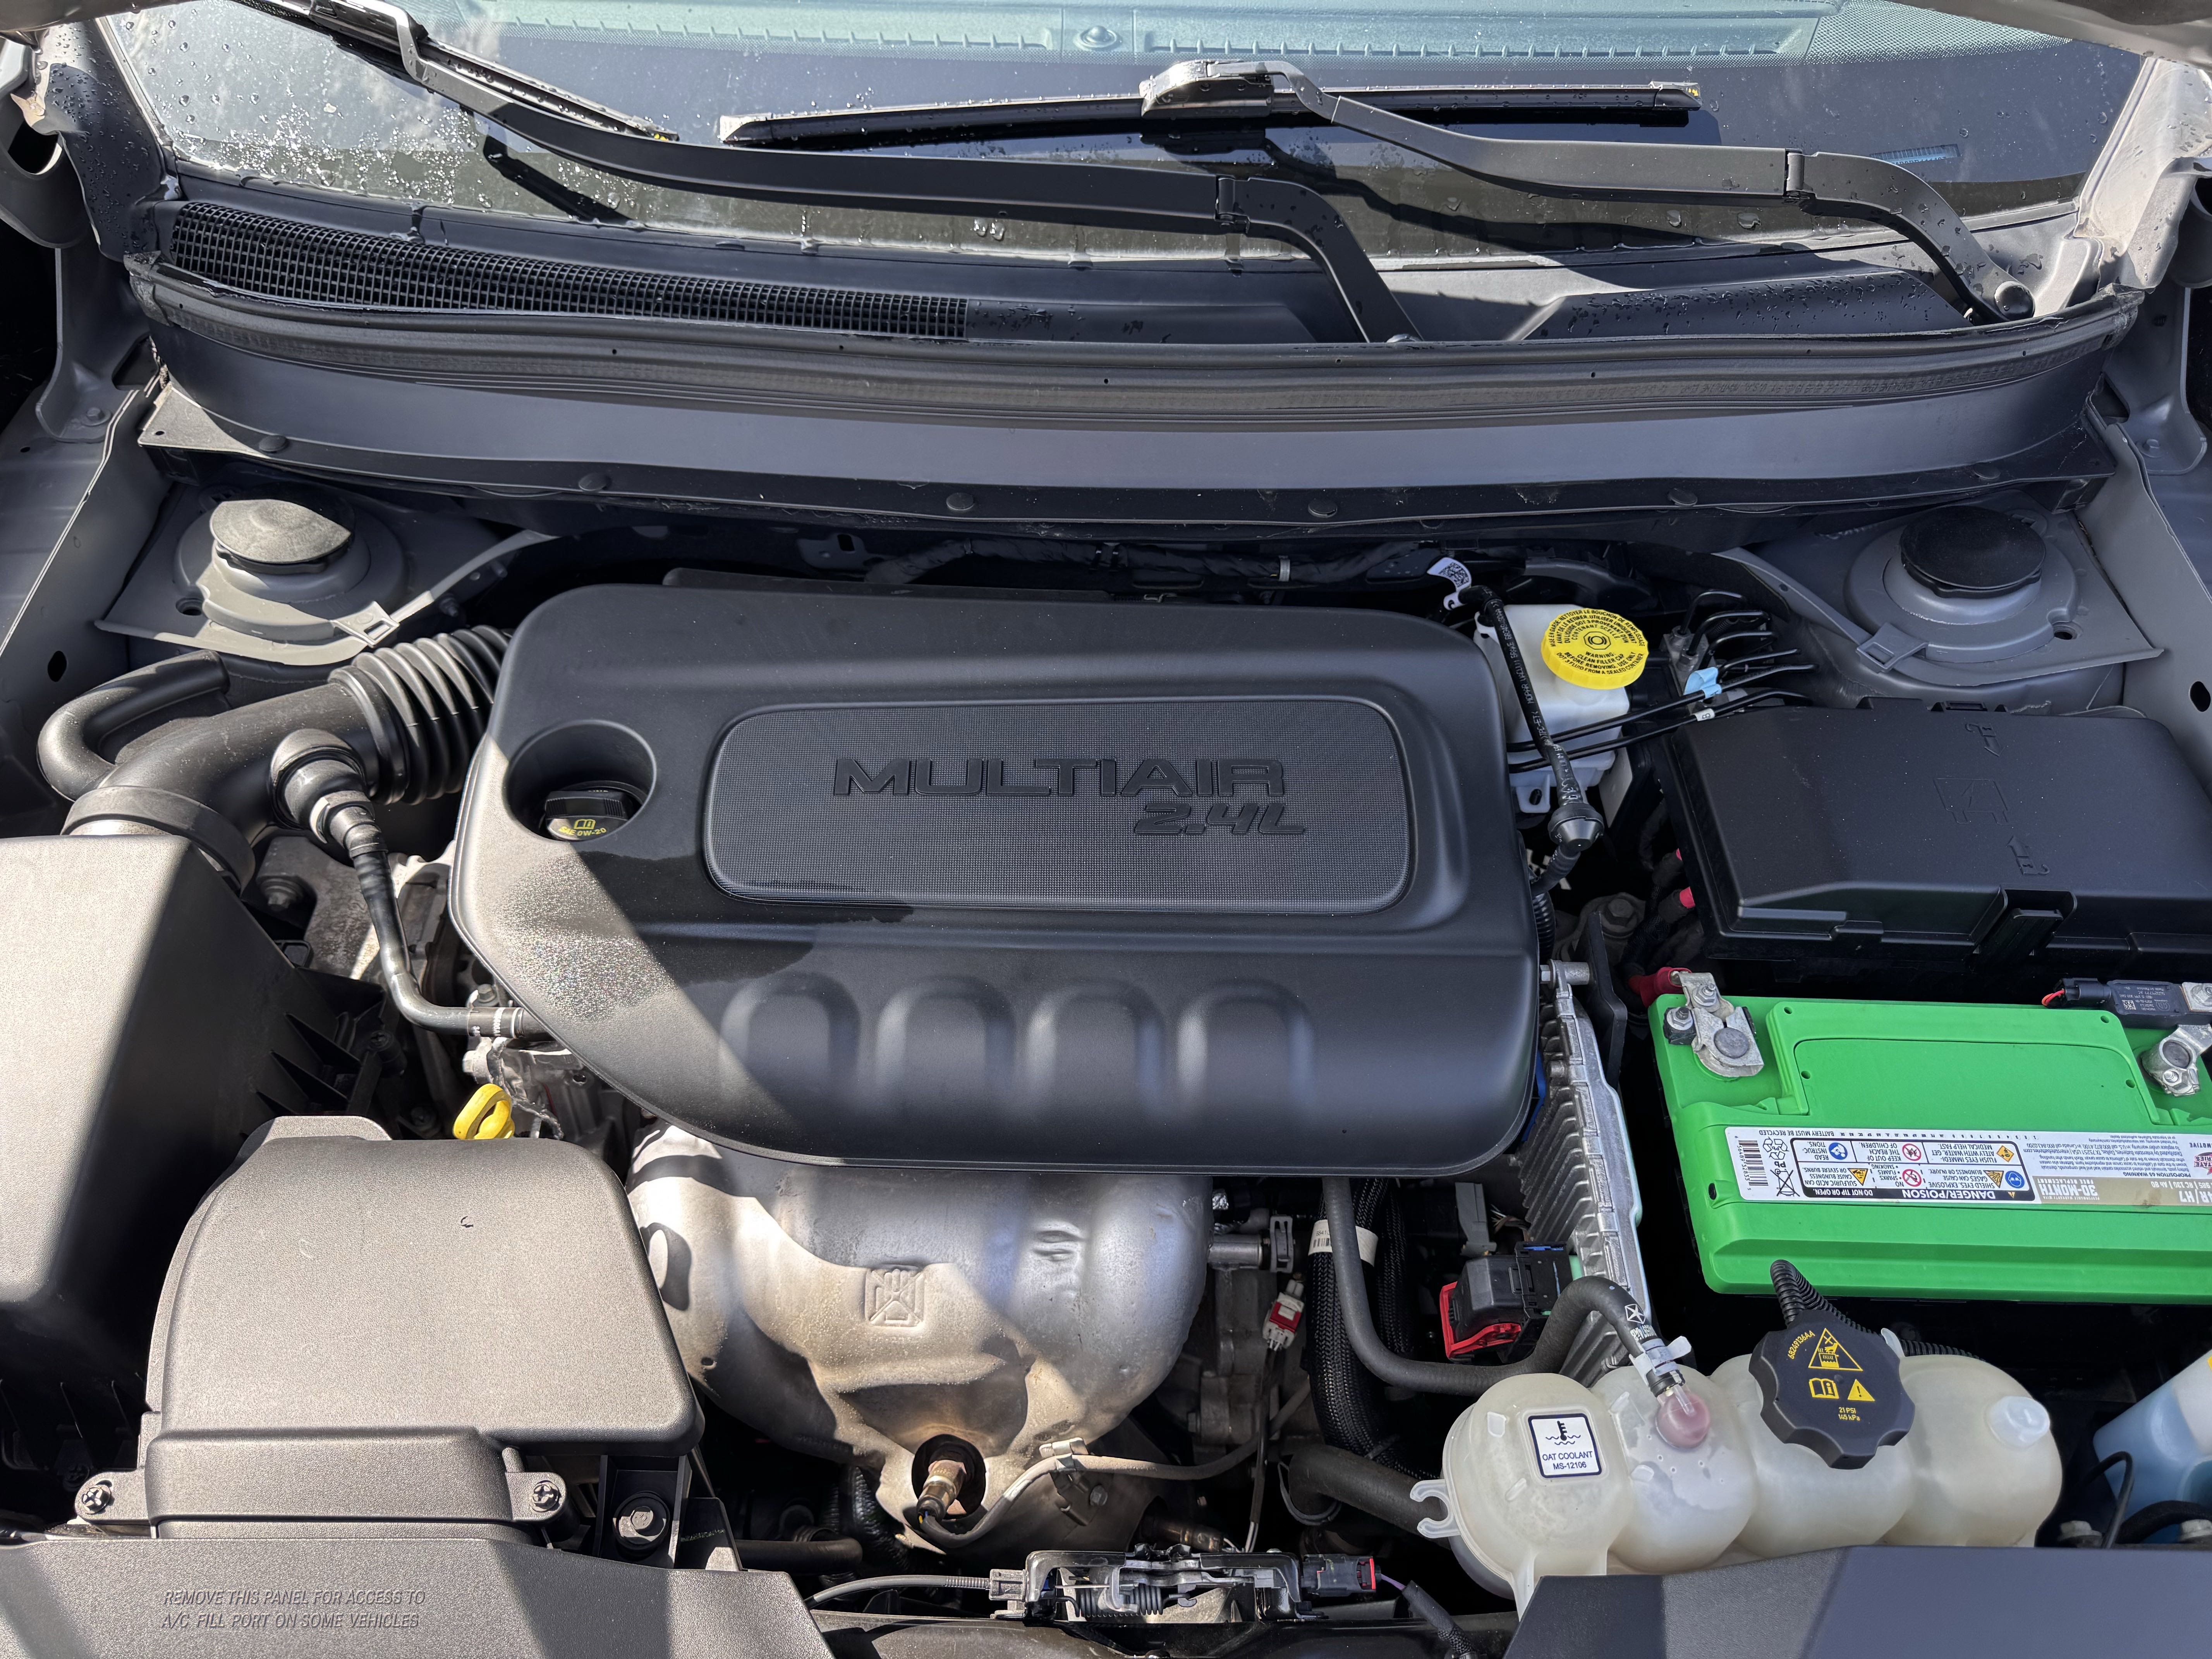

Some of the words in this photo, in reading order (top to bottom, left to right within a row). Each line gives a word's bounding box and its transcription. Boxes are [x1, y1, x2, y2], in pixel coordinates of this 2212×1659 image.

[1558, 610, 1583, 621] NETTOYER
[1592, 610, 1618, 619] BOUCHON
[1571, 624, 1597, 640] CONTENANT
[1589, 615, 1613, 623] UTILISER
[1613, 621, 1637, 643] UNIQUEMENT
[1591, 620, 1623, 634] PROVENANT
[1565, 652, 1584, 665] BEFORE
[1626, 651, 1636, 661] ONLY
[1577, 654, 1595, 663] CLEAN
[1521, 682, 1534, 705] MOPAR
[833, 758, 1285, 795] MULTIAIR
[1134, 802, 1305, 833] 2.4L
[577, 828, 607, 836] 0W-20
[1902, 1189, 1996, 1199] DANGER/POISON
[2038, 1184, 2098, 1196] 30-MONTH
[1788, 1330, 1815, 1359] 68249136AA
[1558, 1451, 1593, 1460] COOLANT
[1553, 1462, 1587, 1470] MS-12106
[164, 1590, 227, 1604] REMOVE
[228, 1590, 261, 1604] THIS
[263, 1590, 312, 1604] PANEL
[312, 1590, 342, 1604] FOR
[346, 1590, 403, 1604] ACCESS
[405, 1590, 425, 1604] TO
[161, 1613, 189, 1628] A/C
[195, 1613, 226, 1628] FILL
[232, 1613, 271, 1628] PORT
[275, 1613, 297, 1628] ON
[301, 1613, 344, 1628] SOME
[349, 1613, 419, 1628] VEHICLES
